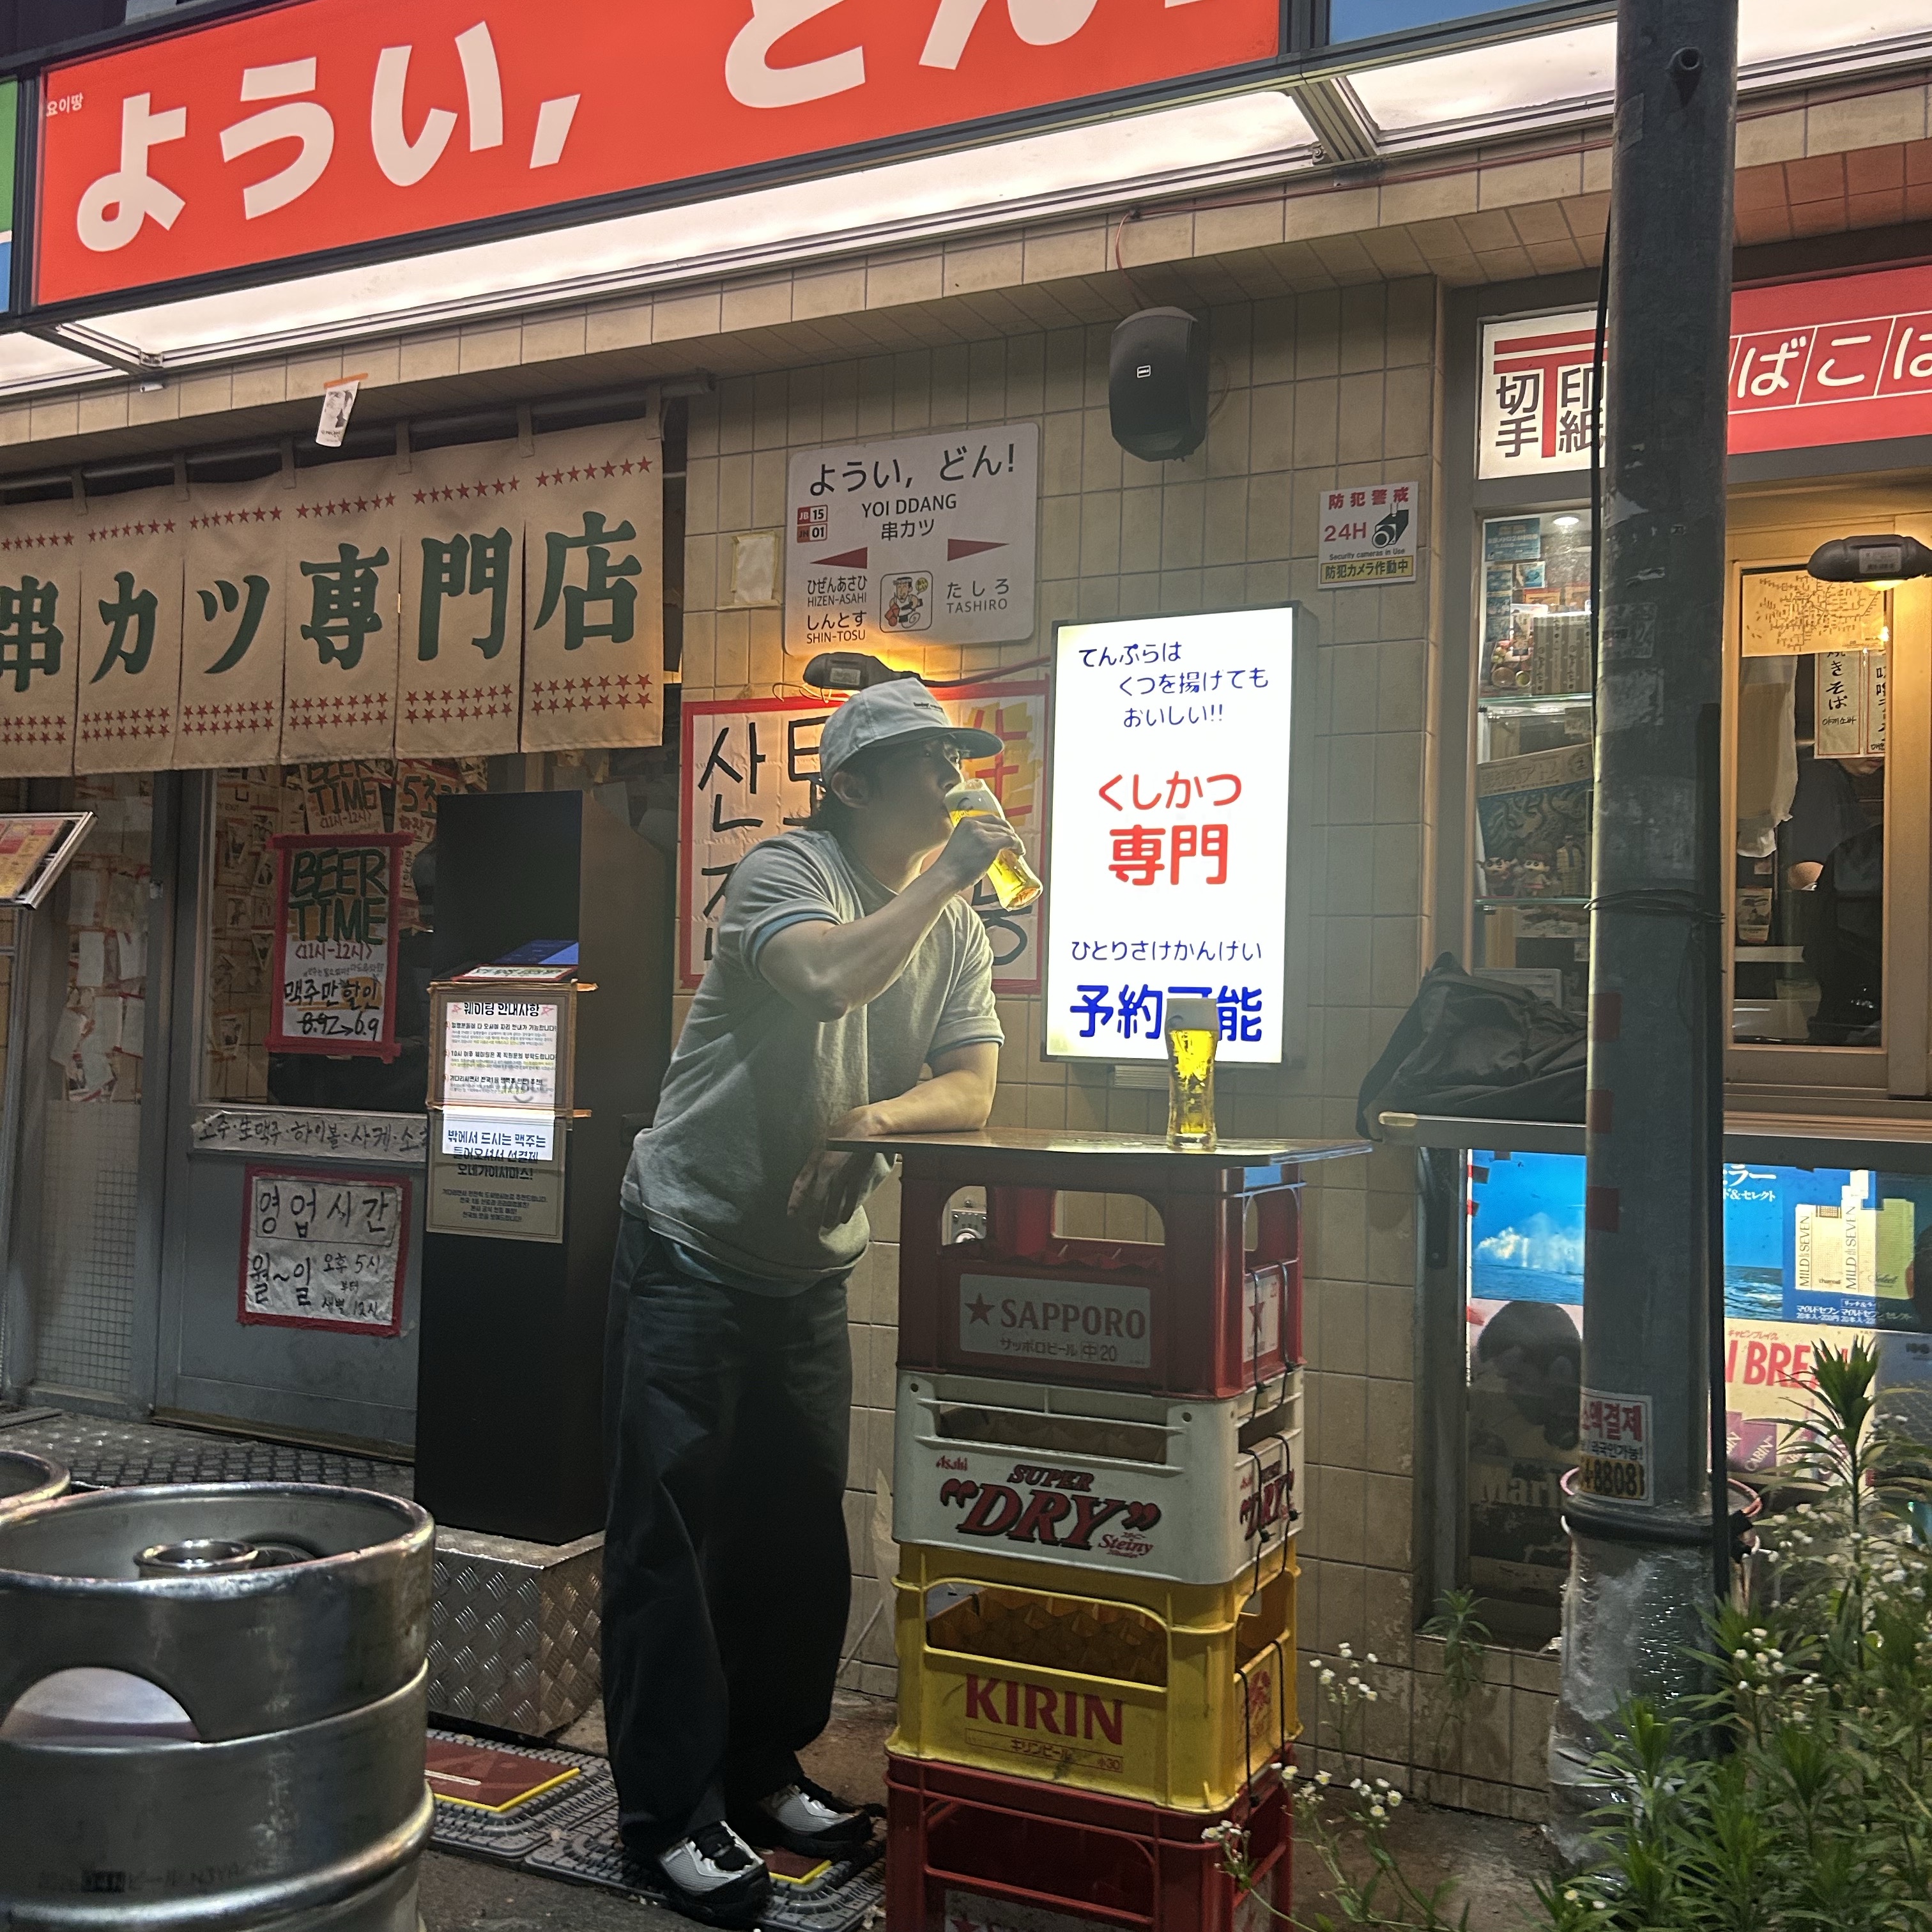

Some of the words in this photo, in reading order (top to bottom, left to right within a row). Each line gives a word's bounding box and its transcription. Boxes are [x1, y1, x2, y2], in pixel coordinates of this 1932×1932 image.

[45, 93, 84, 118] 요이땅
[1496, 373, 1539, 458] 切手
[862, 501, 890, 518] YOI
[896, 493, 957, 515] DDANG
[1328, 486, 1409, 510] 防犯警戒
[812, 509, 825, 521] 15
[811, 526, 825, 539] 01
[881, 518, 935, 541] 串カツ
[1324, 522, 1367, 542] 24H
[1329, 552, 1355, 560] Security
[1356, 549, 1383, 558] cameras
[1325, 559, 1408, 580] 防犯カメラ作動中
[807, 576, 868, 595] ひぜんあさひ
[947, 578, 1009, 598] たしろ
[0, 511, 642, 693] 串カツ専門店
[807, 592, 867, 608] HIZEN-ASAHI
[947, 598, 1008, 614] TASHIRO
[806, 610, 867, 630] しんとす
[806, 629, 866, 644] SHIN-TOSU
[1078, 641, 1182, 668] てんぷらは
[1098, 770, 1242, 811] くしかつ
[1108, 824, 1229, 885] 専門
[290, 848, 388, 898] BEER
[288, 897, 387, 946] TIME
[1070, 984, 1262, 1042] 予約能
[448, 1130, 478, 1144] 밖에서
[480, 1131, 512, 1146] 드시는
[514, 1133, 546, 1148] 맥주는
[1723, 1164, 1777, 1187] ラー
[1799, 1215, 1811, 1251] SEVEN
[1845, 1206, 1857, 1245] SEVEN
[323, 1252, 348, 1273] 오후
[354, 1253, 381, 1275] 5시
[1799, 1257, 1810, 1287] MILD
[1845, 1256, 1857, 1290] MILD
[1000, 1298, 1146, 1340] SAPPORO
[1000, 1337, 1077, 1358] サッポロビール
[1100, 1344, 1117, 1362] 20
[935, 1455, 969, 1472] Asahi
[1006, 1464, 1094, 1492] SUPER
[1098, 1533, 1154, 1555] Steiny
[965, 1673, 1124, 1745] KIRIN
[1010, 1738, 1073, 1760] キリンビール
